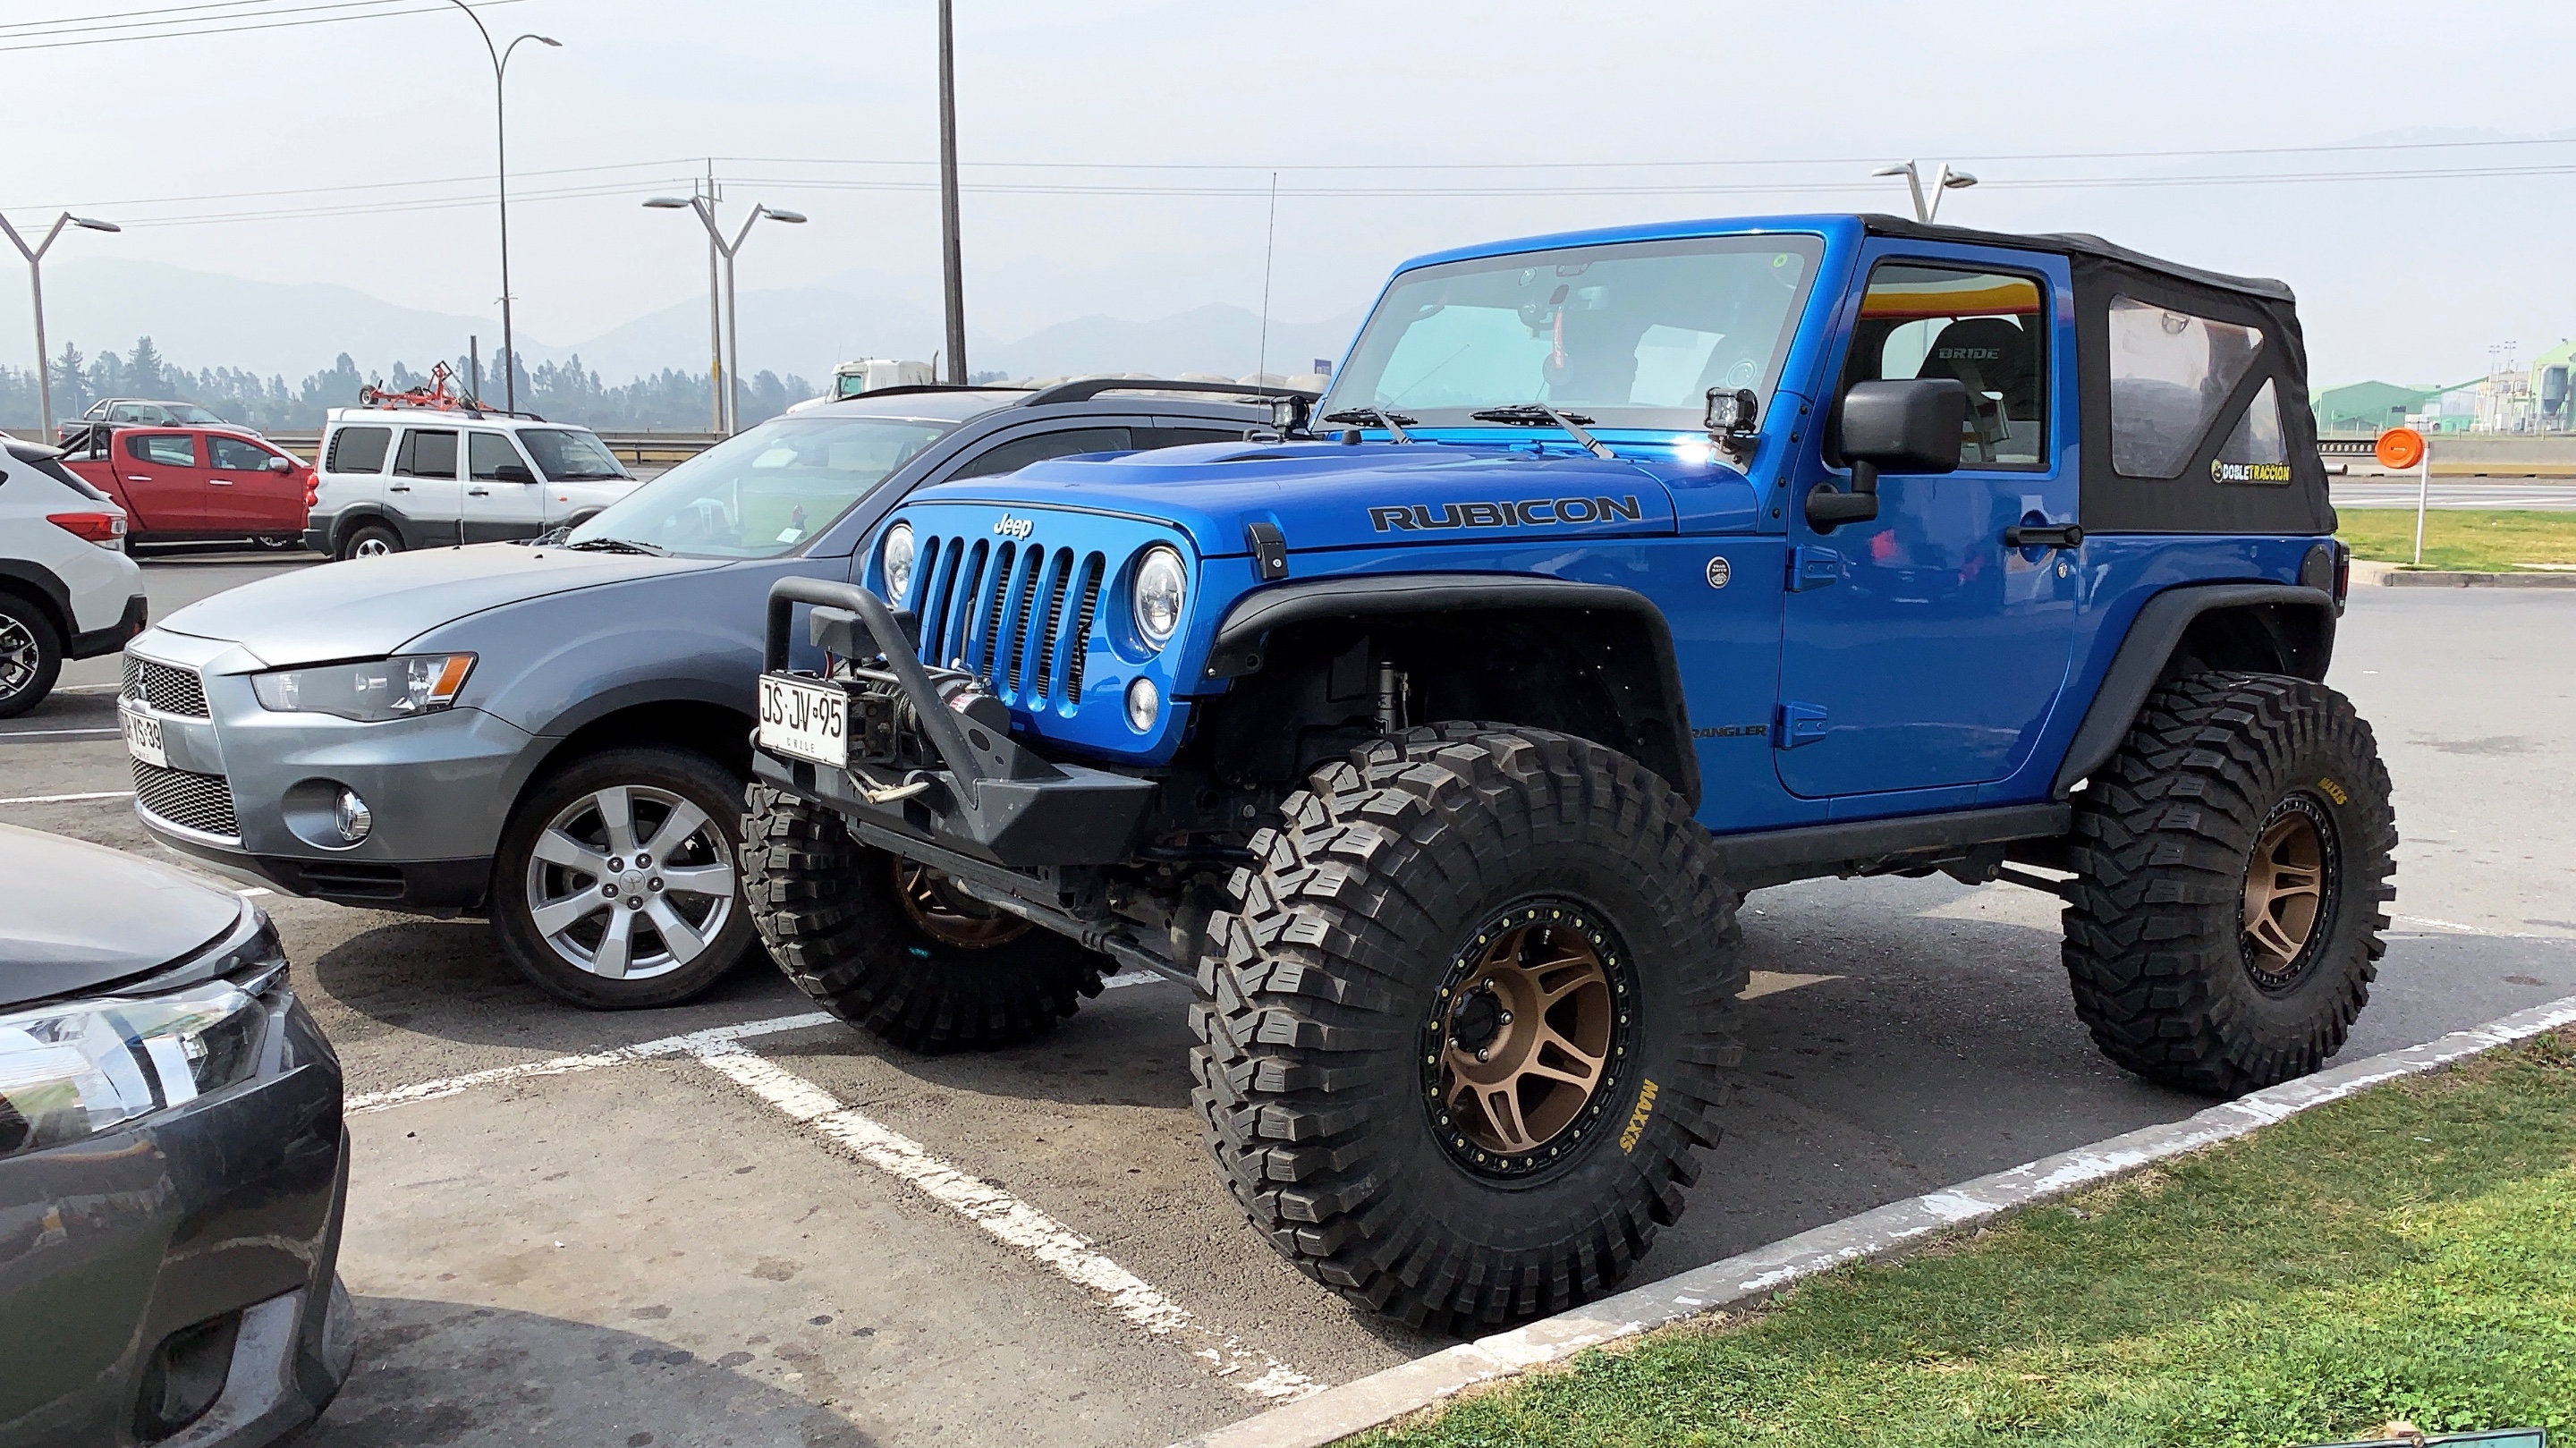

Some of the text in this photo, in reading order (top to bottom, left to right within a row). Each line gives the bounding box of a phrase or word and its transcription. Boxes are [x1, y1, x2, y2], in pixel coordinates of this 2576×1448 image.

[1938, 347, 2000, 360] BRIDE
[994, 512, 1034, 542] Jeep
[1367, 495, 1641, 533] RUBICON
[1691, 725, 1767, 739] RANGLER
[2318, 777, 2349, 805] MAXXIS
[1619, 1078, 1659, 1155] MAXXIS
